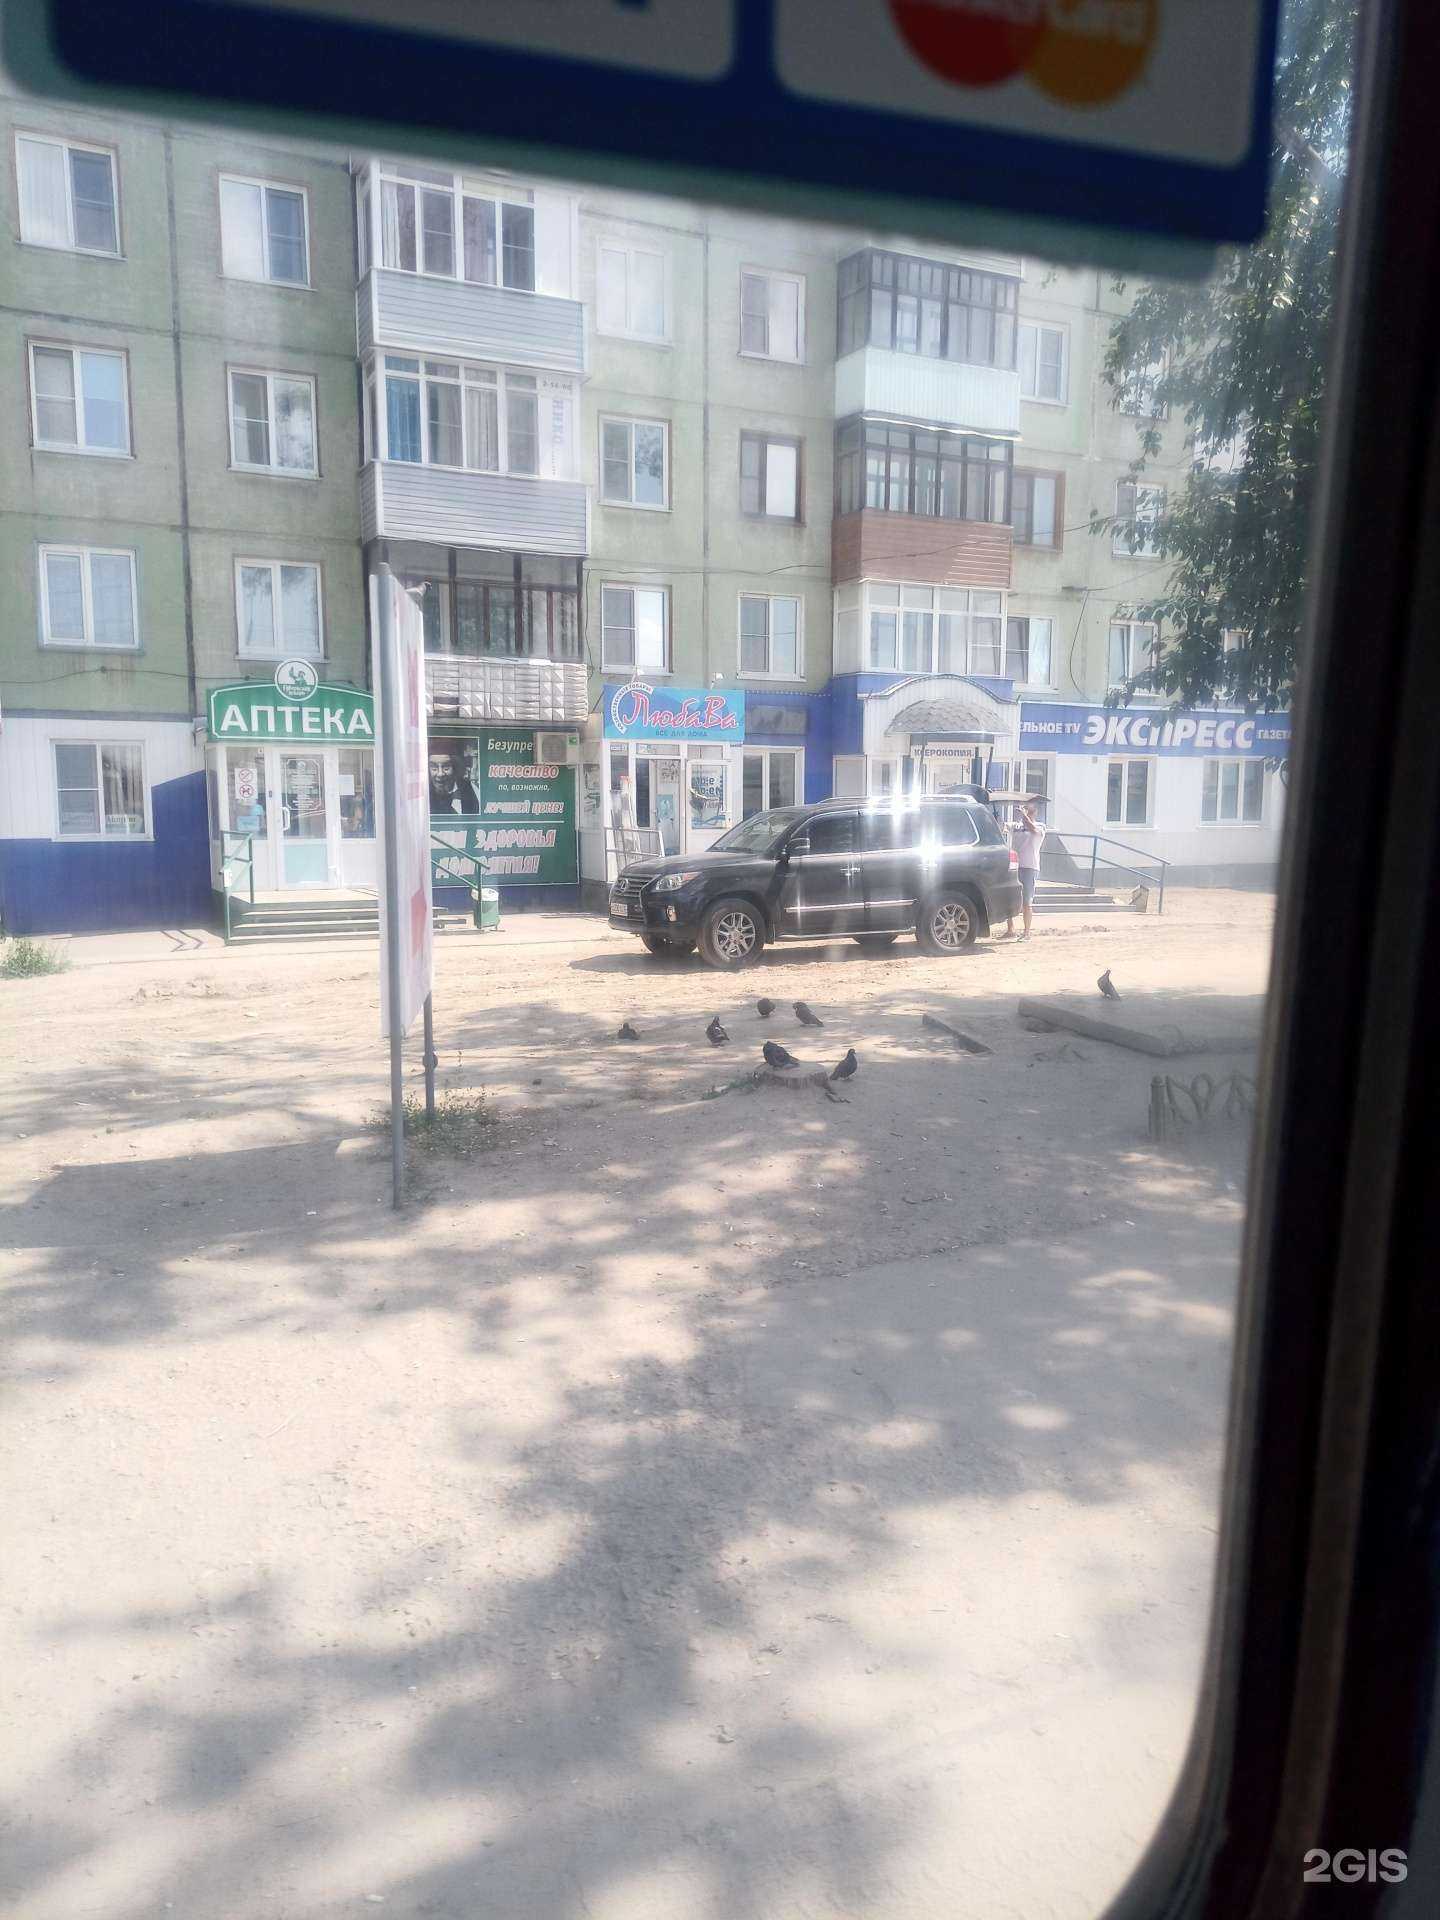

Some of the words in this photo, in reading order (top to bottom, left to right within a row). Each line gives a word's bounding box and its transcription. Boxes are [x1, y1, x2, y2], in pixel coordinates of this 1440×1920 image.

[220, 704, 373, 735] АПТЕКА
[1065, 723, 1080, 733] TV
[1082, 715, 1255, 748] ЭКСПРЕСС
[488, 738, 534, 753] Безупре
[488, 764, 560, 779] качество
[498, 784, 509, 792] по,
[474, 829, 557, 851] ЗДОРОВЬЯ
